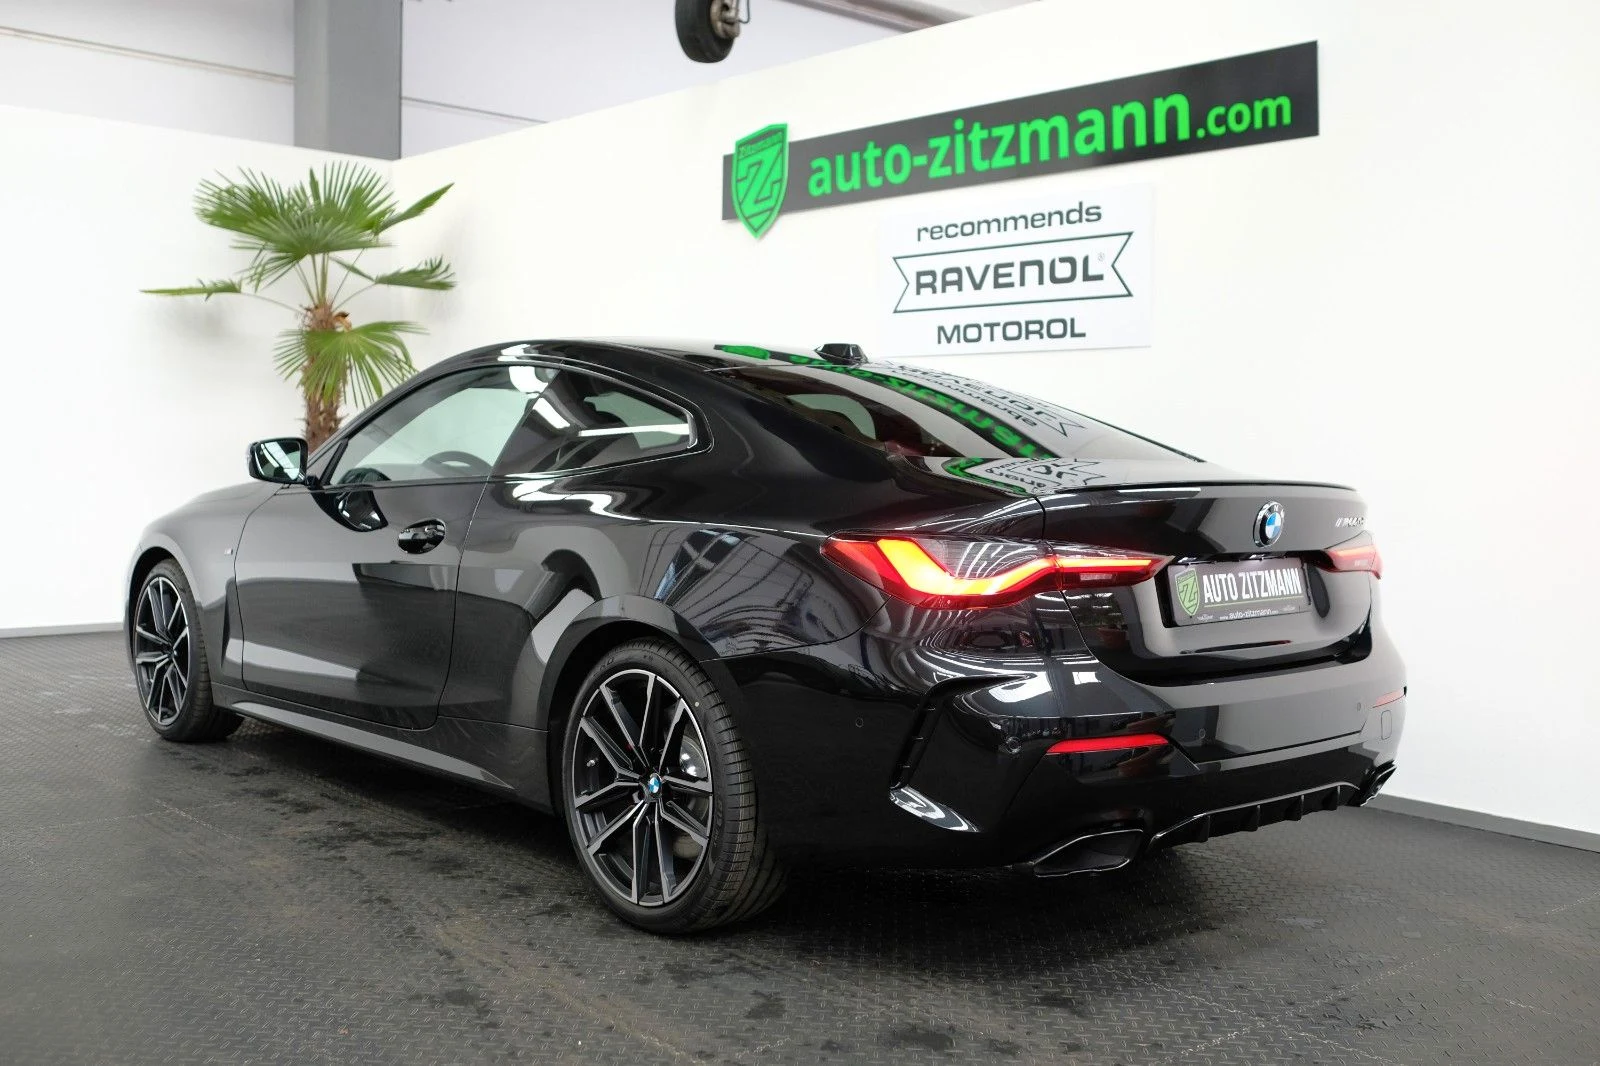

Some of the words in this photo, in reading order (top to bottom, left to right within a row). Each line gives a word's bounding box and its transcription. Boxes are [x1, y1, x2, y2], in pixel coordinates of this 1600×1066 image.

[808, 92, 1292, 196] auto-zitzmann.com
[916, 201, 1102, 242] recommends
[915, 254, 1105, 296] RAVENOL
[937, 317, 1087, 345] MOTOROL
[1203, 573, 1237, 603] AUTO
[1240, 567, 1302, 600] ZITZMANN
